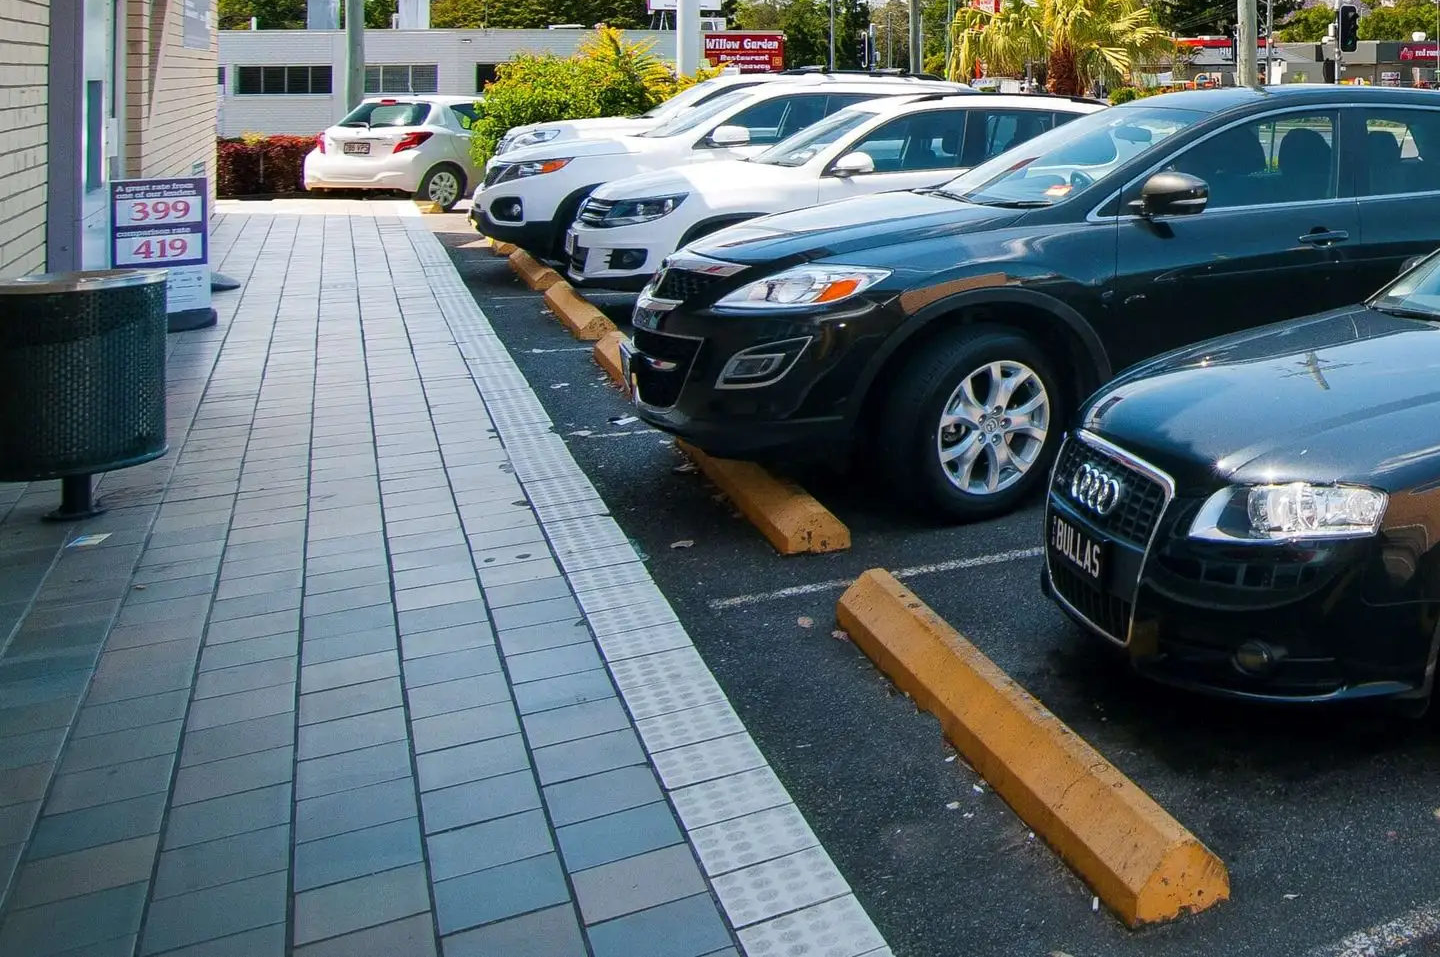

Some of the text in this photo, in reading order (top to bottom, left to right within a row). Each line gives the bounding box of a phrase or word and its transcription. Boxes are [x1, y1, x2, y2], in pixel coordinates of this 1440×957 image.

[705, 38, 779, 50] Willow Garden
[1415, 48, 1426, 57] red
[116, 185, 124, 193] A
[126, 184, 150, 192] great
[130, 200, 191, 221] 399
[116, 229, 170, 239] comparison
[133, 238, 188, 259] 419
[1056, 517, 1100, 579] BULLAS
